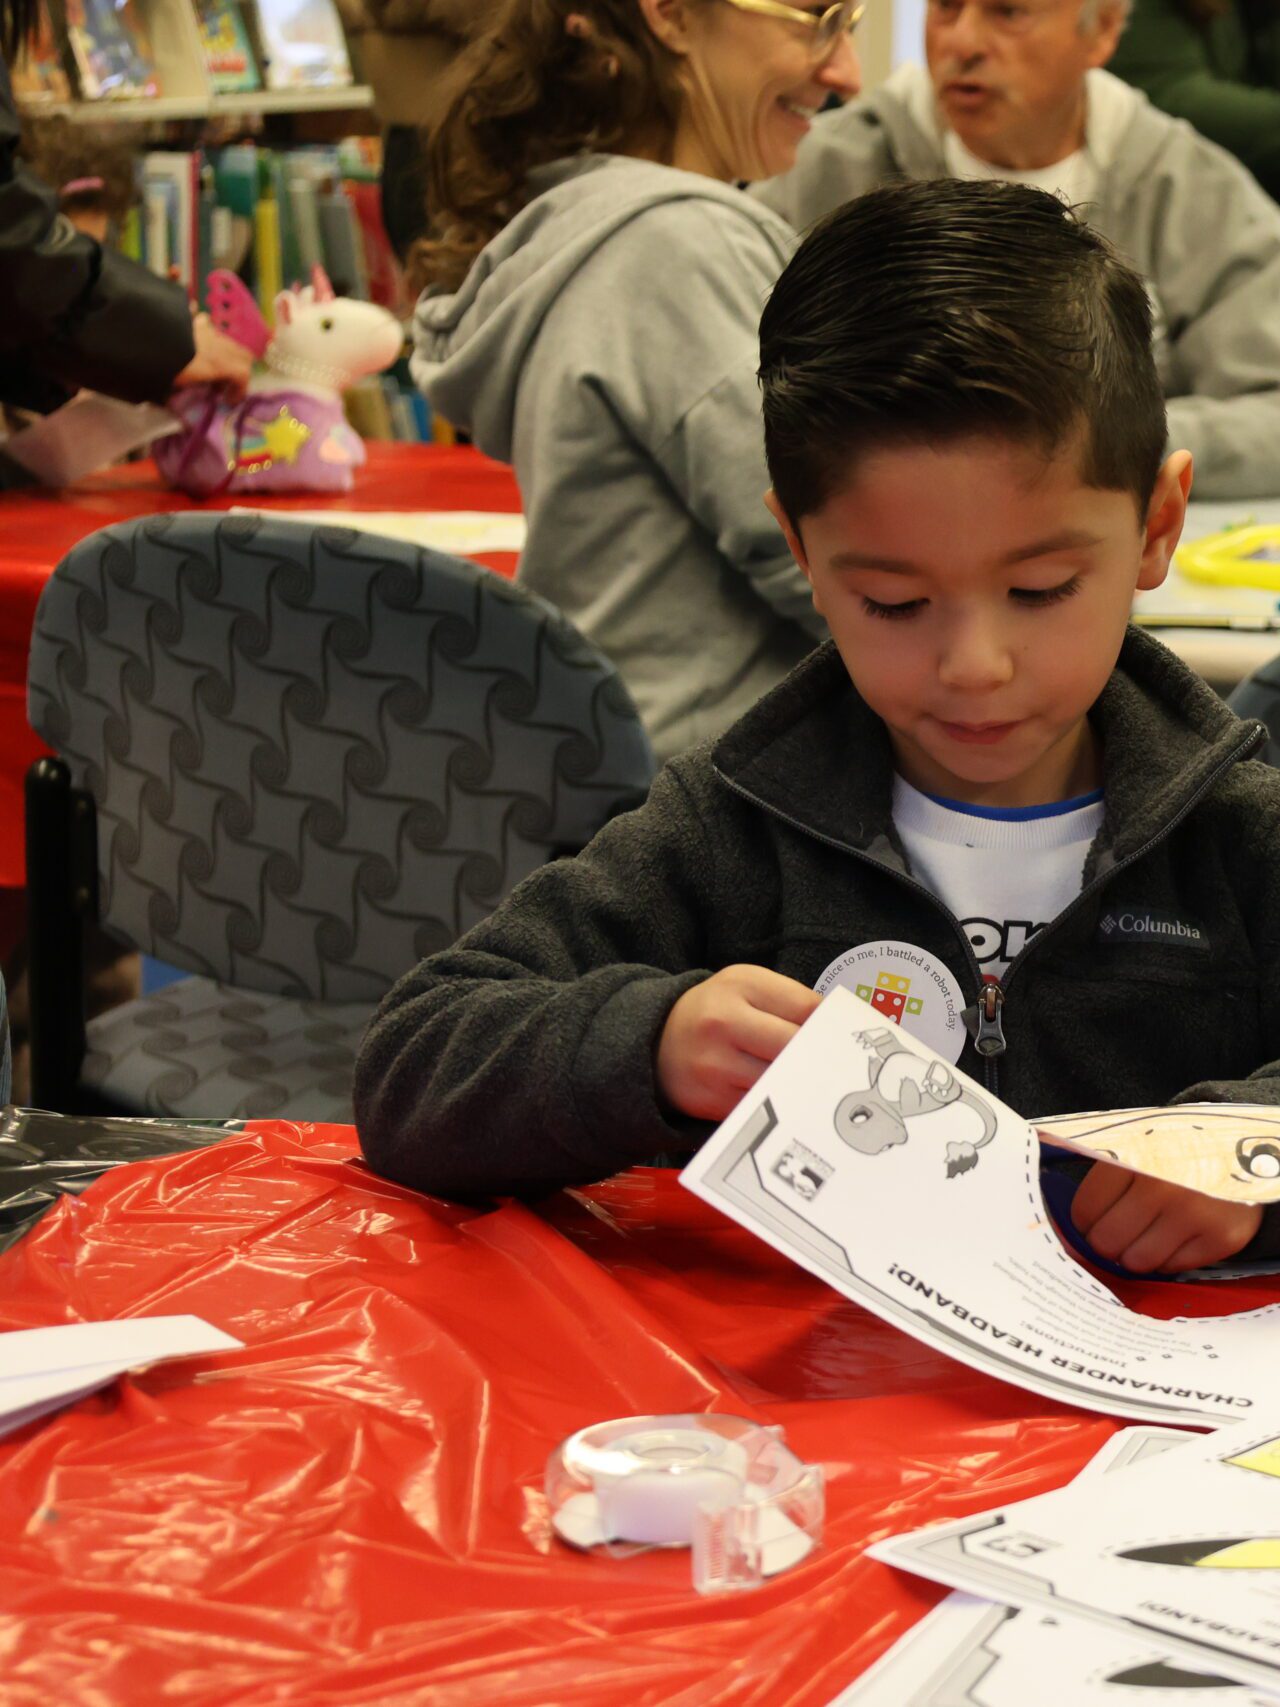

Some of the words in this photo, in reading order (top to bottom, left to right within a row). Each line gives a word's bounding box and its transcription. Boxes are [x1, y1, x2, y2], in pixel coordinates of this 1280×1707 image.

[1118, 913, 1200, 939] Columbia
[825, 963, 843, 984] nice
[844, 956, 855, 966] to
[858, 948, 877, 961] me,
[879, 946, 883, 957] I
[886, 945, 924, 967] battled
[923, 964, 931, 973] a
[930, 970, 952, 998] robot
[945, 998, 958, 1032] today.
[887, 1262, 1043, 1358] HEADBAND!
[1020, 1320, 1128, 1369] Instructions:
[1051, 1355, 1254, 1408] CHARMANDER
